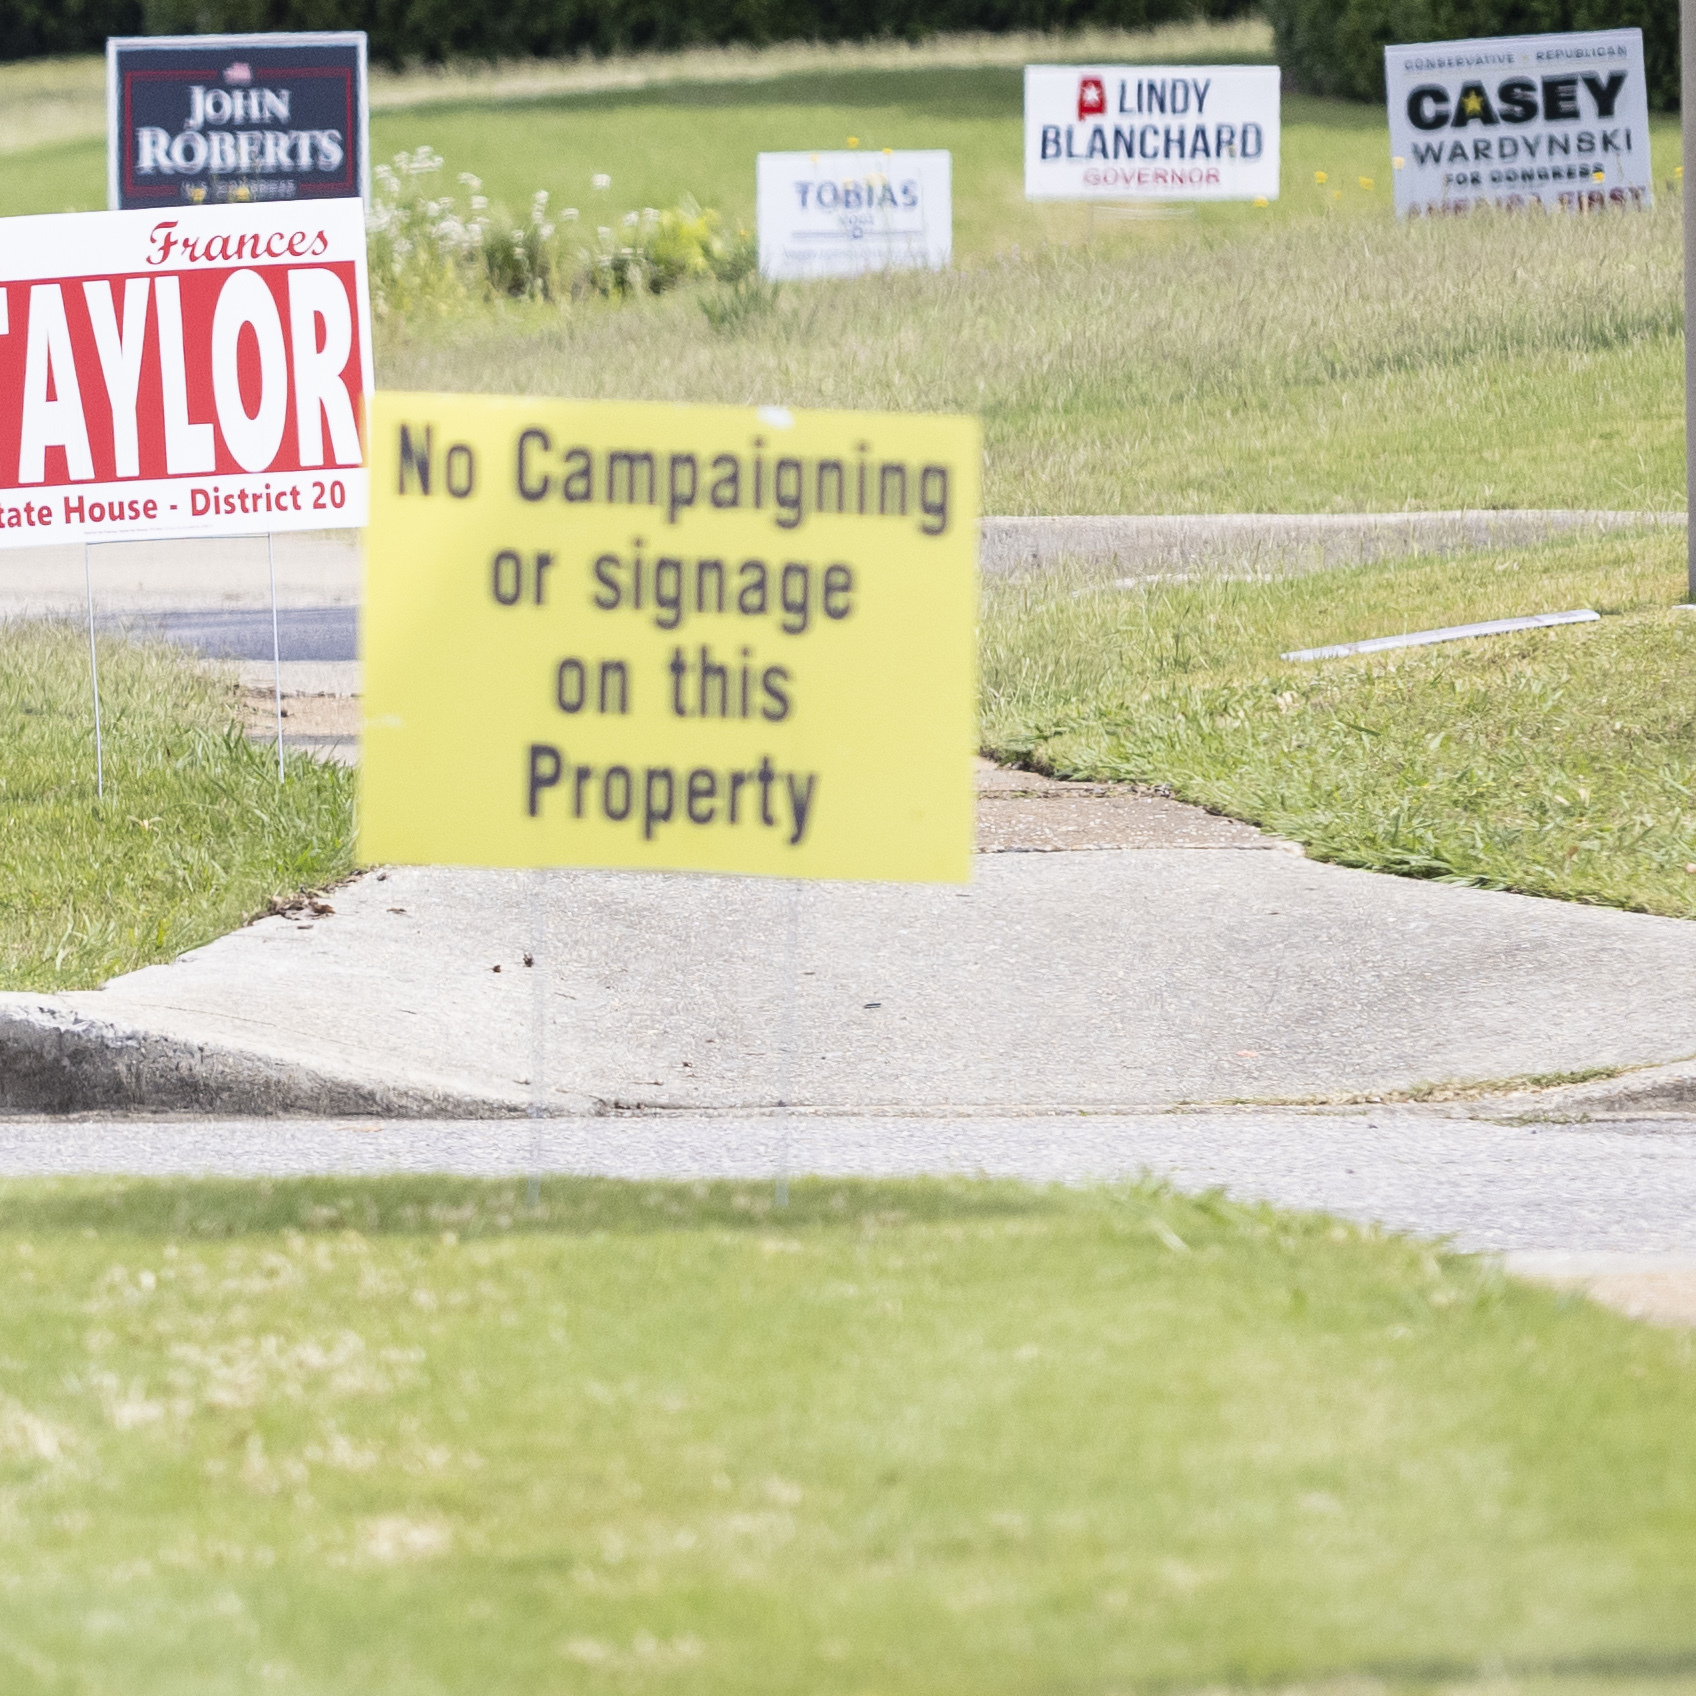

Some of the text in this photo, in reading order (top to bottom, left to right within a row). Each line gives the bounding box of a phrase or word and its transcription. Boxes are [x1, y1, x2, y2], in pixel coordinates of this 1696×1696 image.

[1404, 45, 1627, 70] CONSERVATIVE REPUBLICAN
[188, 84, 290, 127] JOHN
[1118, 78, 1211, 115] LINDY
[1407, 70, 1627, 130] CASEY
[136, 127, 343, 175] ROBERTS
[1040, 123, 1264, 161] BLANCHARD
[1411, 128, 1633, 166] WARDYNSKI
[793, 178, 918, 210] TOBIAS
[1083, 166, 1220, 187] GOVERNOR
[145, 220, 328, 265] Frances
[63, 494, 158, 524] House
[190, 483, 300, 517] District
[311, 480, 347, 510] 20
[396, 423, 952, 537] No Campaigning
[491, 537, 856, 635] or signage
[554, 644, 795, 723] on this
[526, 742, 818, 846] Property
